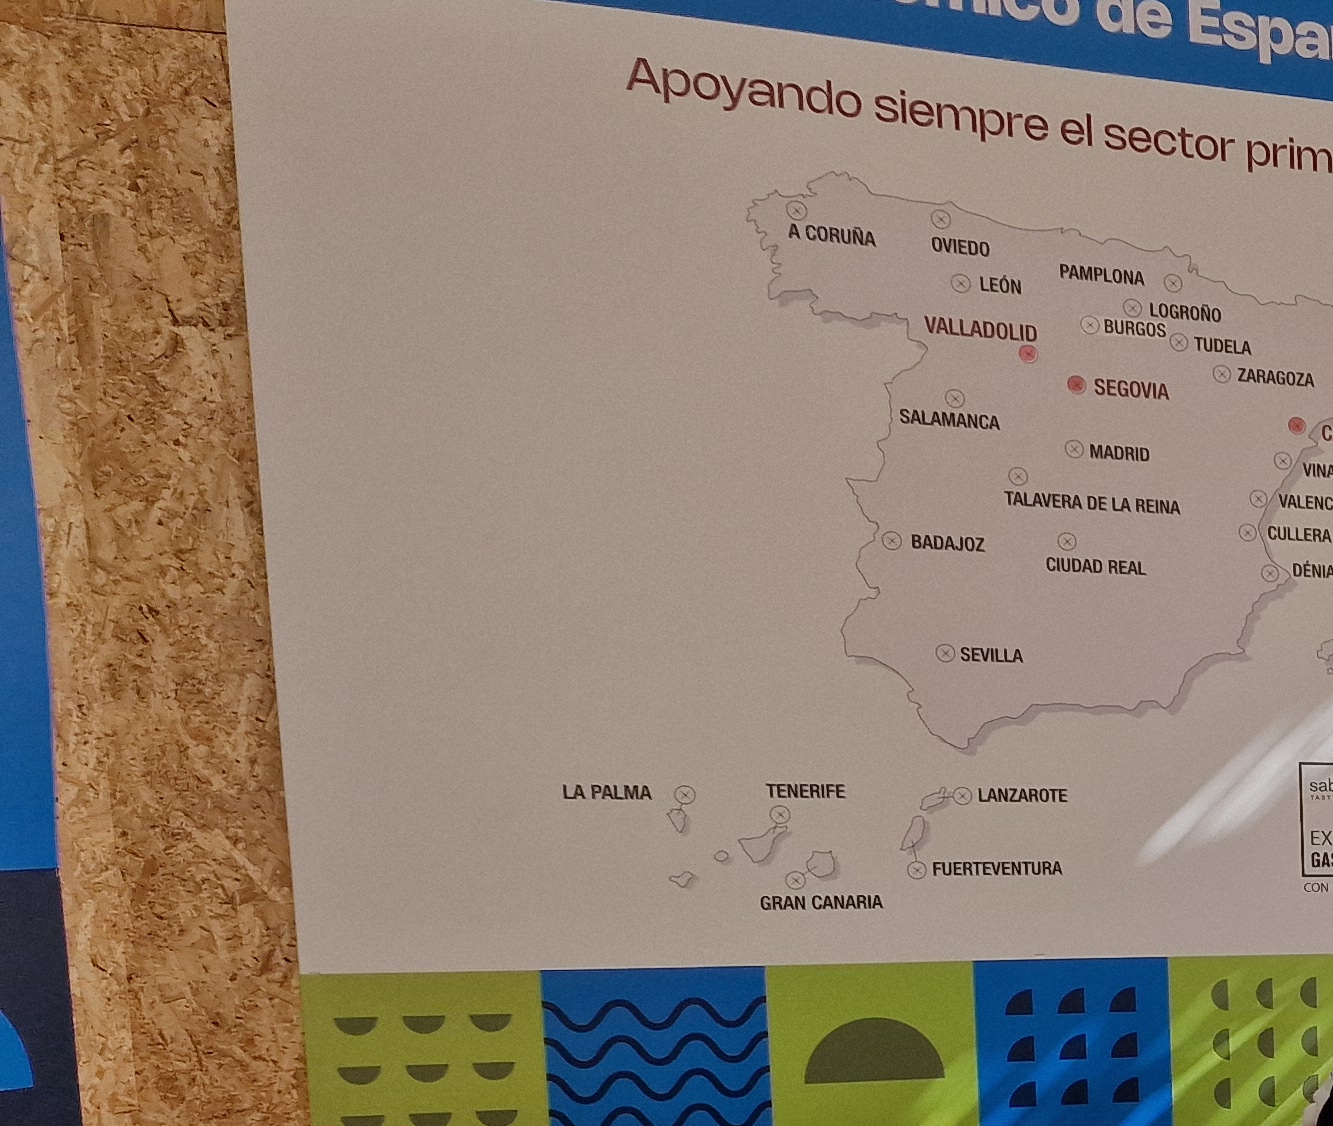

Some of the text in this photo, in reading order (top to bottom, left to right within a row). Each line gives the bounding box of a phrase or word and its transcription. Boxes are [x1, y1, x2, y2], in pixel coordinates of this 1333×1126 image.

[627, 58, 861, 117] Apoyando
[875, 90, 1048, 142] siempre
[1061, 113, 1092, 146] el
[1105, 124, 1235, 161] sector
[789, 223, 876, 247] A CORUÑA
[932, 237, 990, 257] OVIEDO
[1060, 264, 1144, 286] PAMPLONA
[980, 275, 1021, 294] LEÓN
[1149, 302, 1221, 323] LOGROÑO
[924, 316, 1037, 342] VALLADOLID
[1104, 319, 1167, 337] BURGOS
[1194, 337, 1251, 355] TUDELA
[1238, 368, 1314, 387] ZARAGOZA
[1095, 379, 1169, 400] SEGOVIA
[900, 409, 1000, 430] SALAMANCA
[1090, 444, 1149, 461] MADRID
[1004, 491, 1180, 514] TALAVERA DE LA REINA
[912, 534, 985, 552] BADAJOZ
[1268, 526, 1332, 543] CULLERA
[1046, 557, 1146, 575] CIUDAD REAL
[961, 647, 1023, 663] SEVILLA
[563, 785, 652, 800] LA PALMA
[766, 784, 845, 798] TENERIFE
[979, 788, 1067, 802] LANZAROTE
[933, 861, 1062, 876] FUERTEVENTURA
[1304, 883, 1328, 892] CON
[761, 895, 883, 910] GRAN CANARIA
